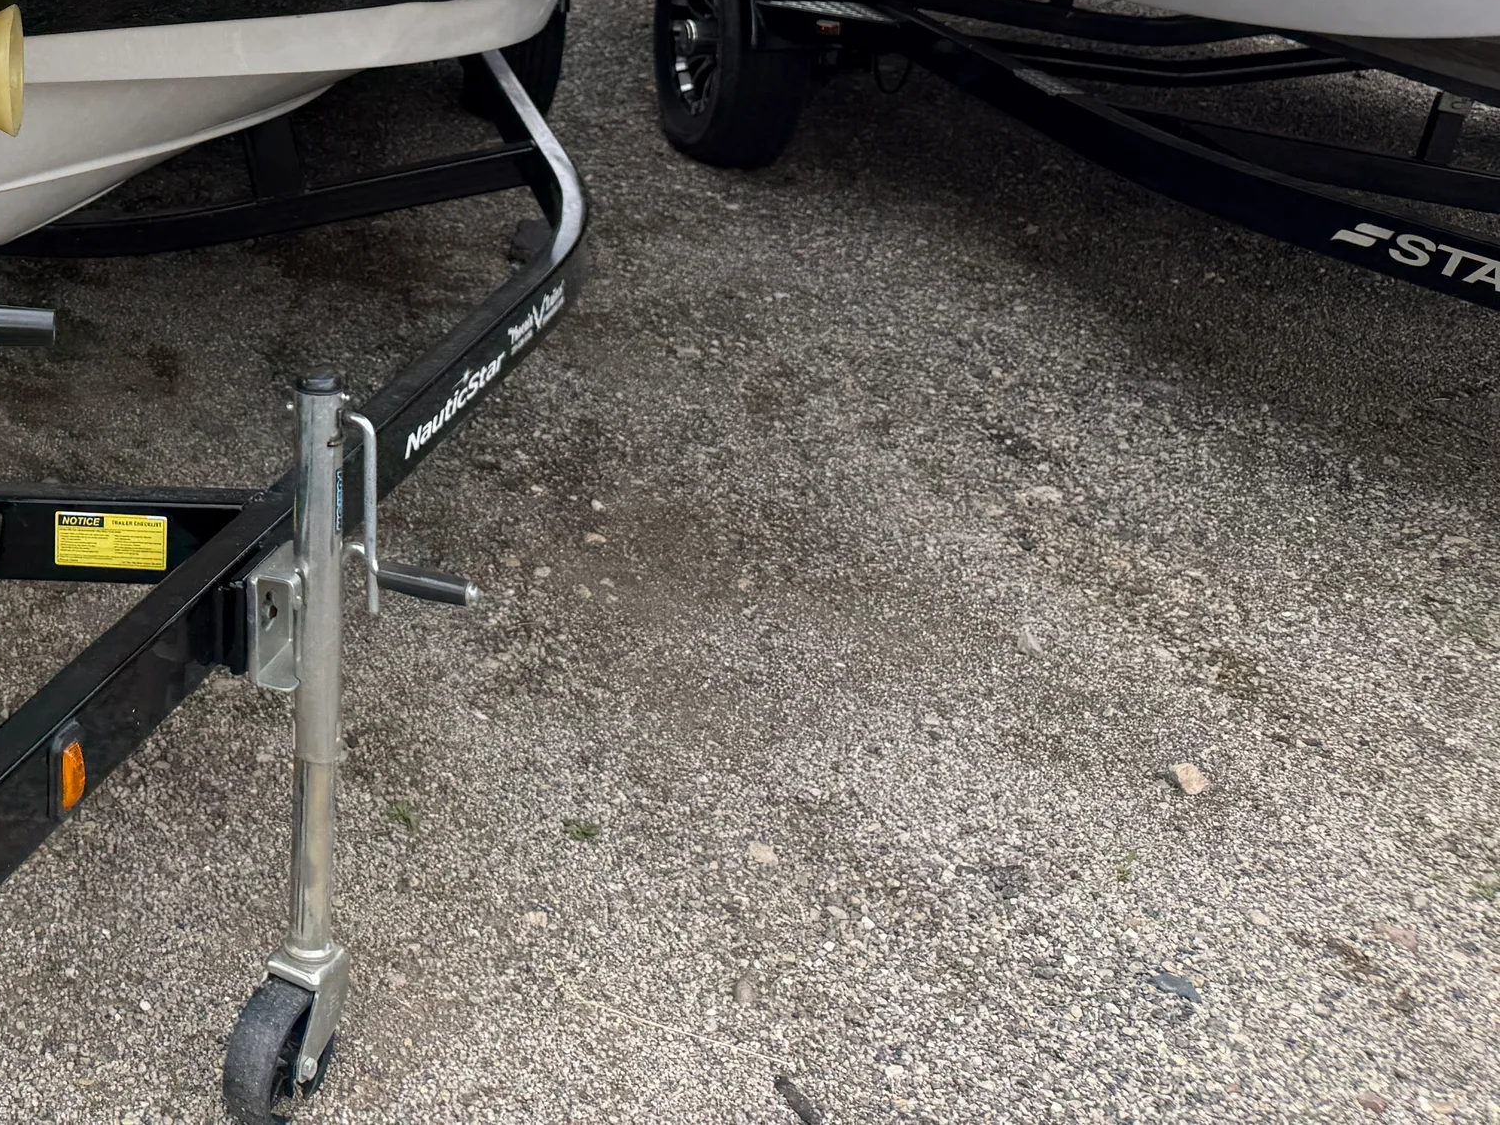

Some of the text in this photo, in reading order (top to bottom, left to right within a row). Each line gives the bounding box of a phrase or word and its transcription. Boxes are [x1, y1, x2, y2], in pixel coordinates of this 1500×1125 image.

[404, 351, 506, 460] NauticStar
[62, 515, 101, 526] NOTICE
[134, 520, 162, 528] CHECKLIST
